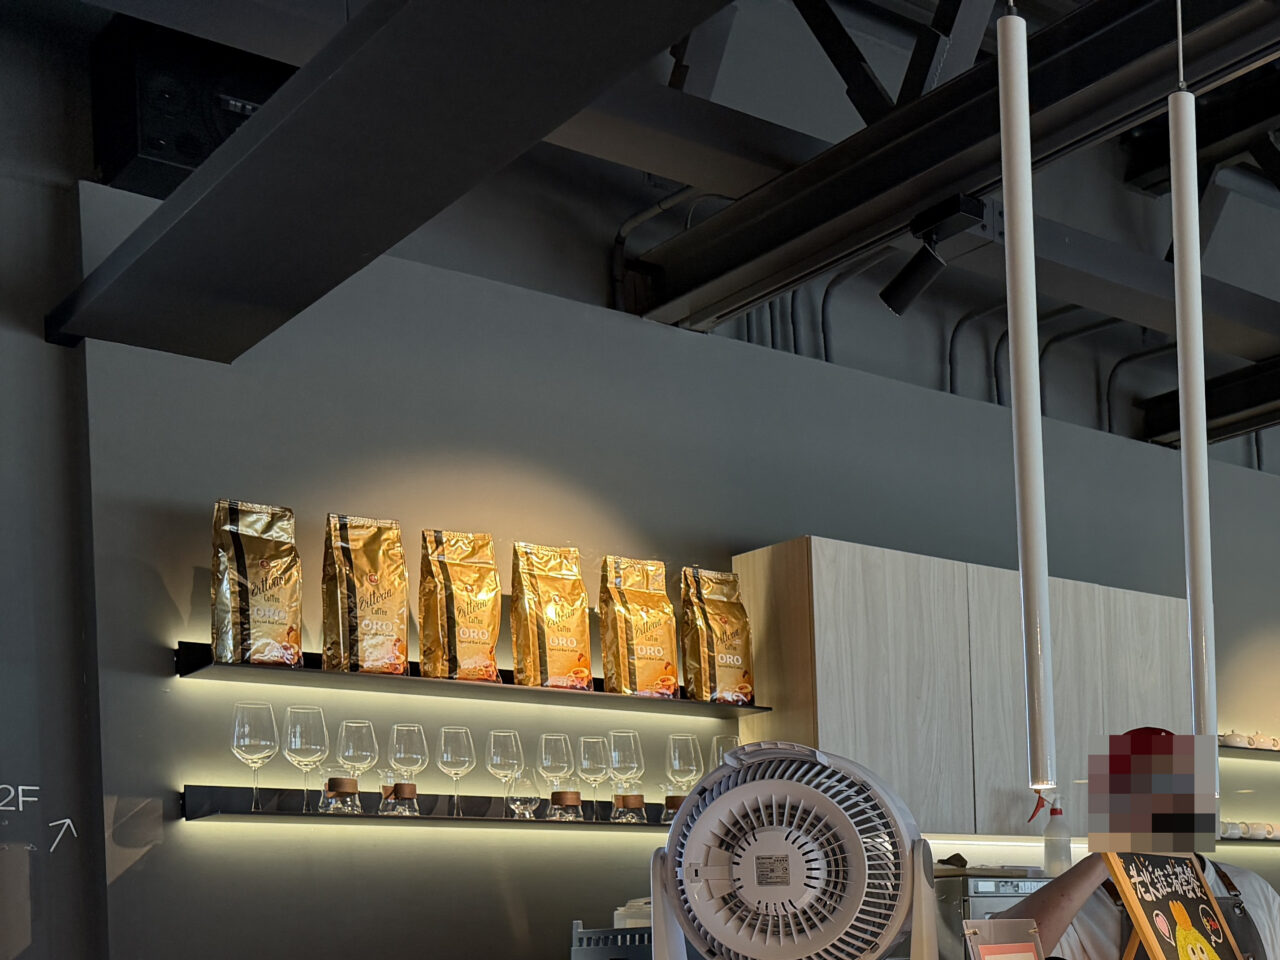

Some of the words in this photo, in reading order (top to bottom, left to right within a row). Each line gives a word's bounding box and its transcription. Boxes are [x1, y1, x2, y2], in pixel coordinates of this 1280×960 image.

[253, 607, 287, 620] ORO
[371, 606, 388, 616] Coffee
[360, 619, 393, 632] ORO
[468, 615, 483, 625] Coffee
[459, 628, 489, 640] ORO
[549, 636, 577, 648] ORO
[637, 645, 664, 657] ORO
[718, 653, 742, 665] ORO
[0, 784, 40, 811] 2F
